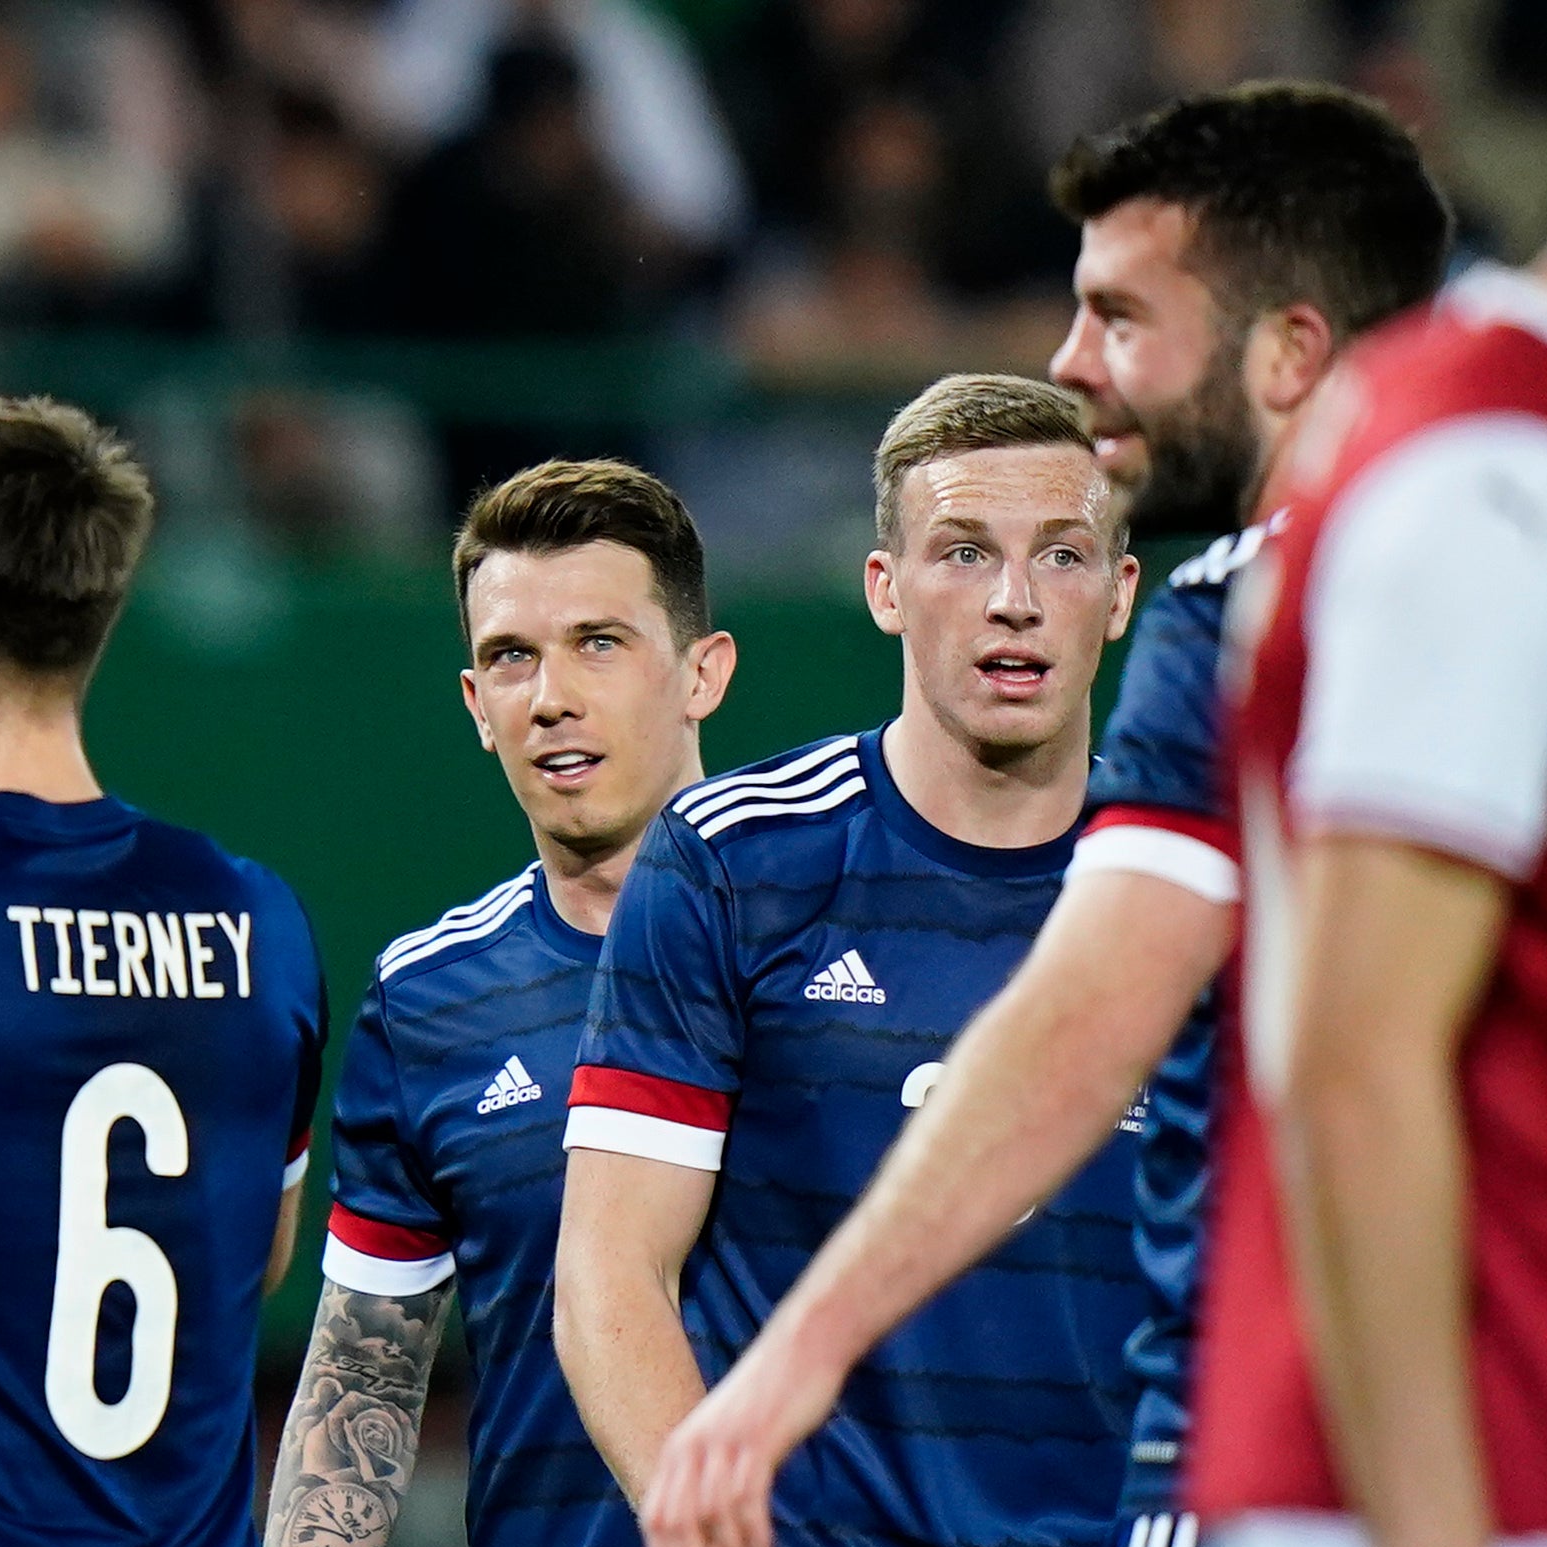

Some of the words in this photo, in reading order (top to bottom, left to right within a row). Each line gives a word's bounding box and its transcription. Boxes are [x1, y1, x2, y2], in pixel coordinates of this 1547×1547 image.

[7, 905, 251, 999] TIERNEY
[804, 982, 886, 1005] adidas
[477, 1084, 542, 1115] adidas
[45, 1062, 190, 1461] 6
